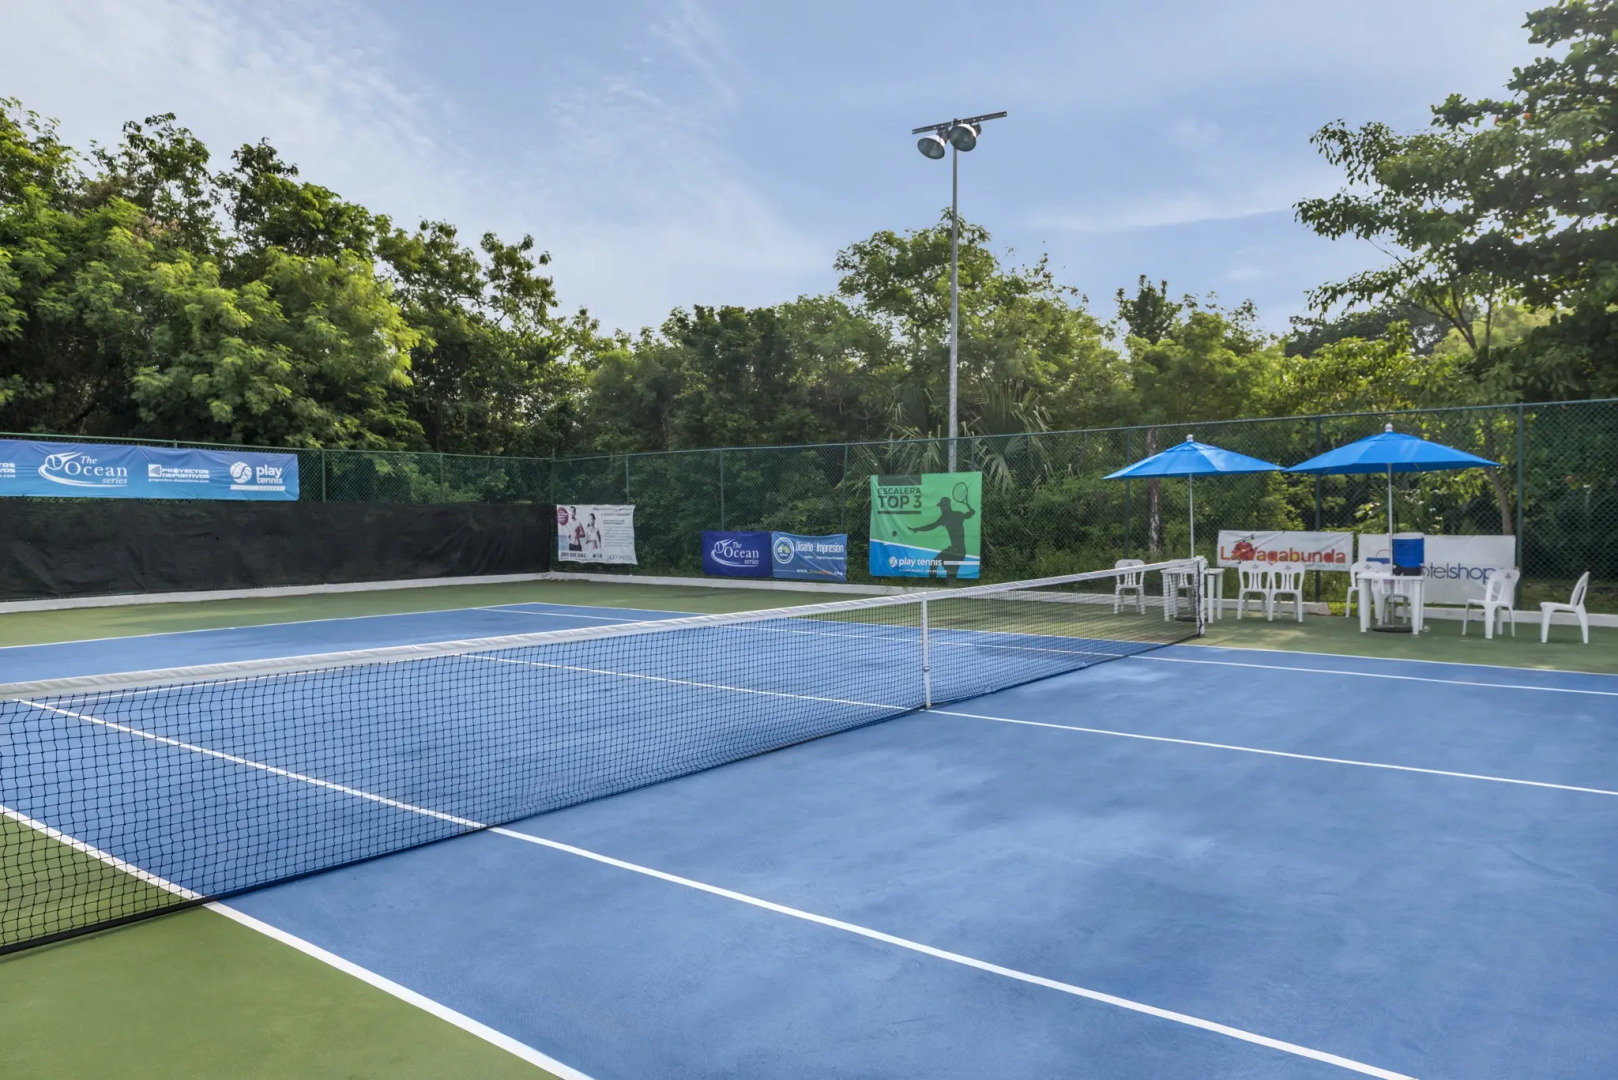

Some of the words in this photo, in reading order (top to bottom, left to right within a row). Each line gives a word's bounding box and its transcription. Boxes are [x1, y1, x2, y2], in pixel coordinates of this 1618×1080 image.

[80, 455, 98, 464] The
[64, 461, 128, 477] Ocean
[255, 464, 283, 477] play
[101, 477, 128, 485] series
[256, 476, 283, 484] tennis
[877, 487, 921, 495] ESCALERA
[877, 495, 910, 509] TOP
[913, 494, 922, 509] 3
[732, 541, 742, 549] The
[795, 541, 814, 552] Diseño
[816, 542, 844, 554] Impresión
[723, 547, 759, 559] Ocean
[899, 557, 915, 567] play
[917, 558, 942, 566] tennis
[1422, 562, 1496, 584] otelshop
